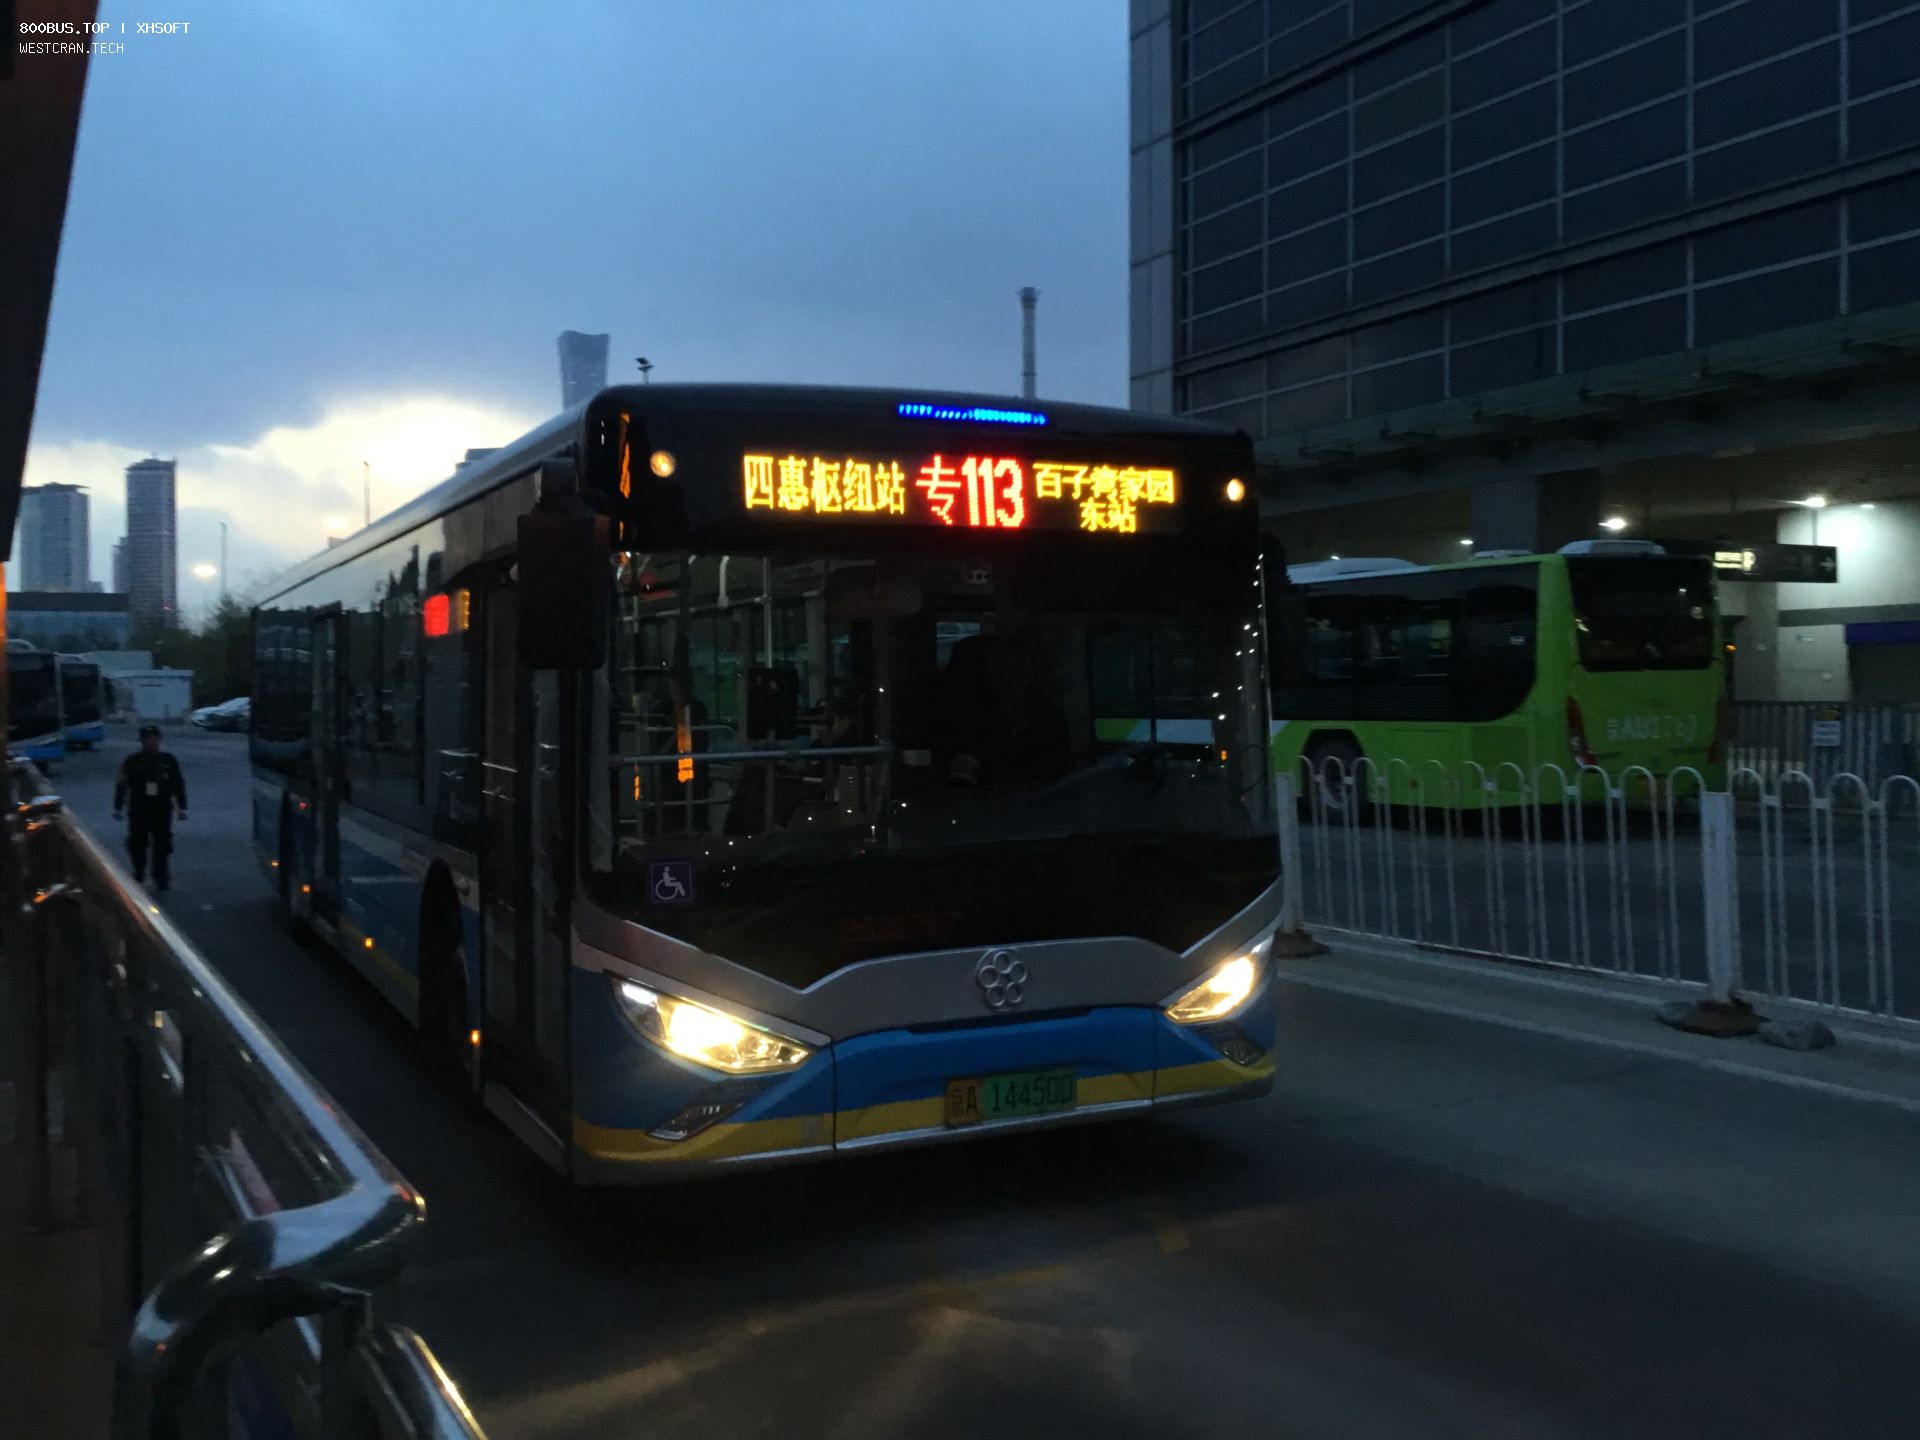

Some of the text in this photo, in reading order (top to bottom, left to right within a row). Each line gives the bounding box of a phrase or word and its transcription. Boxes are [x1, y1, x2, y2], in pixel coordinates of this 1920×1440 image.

[743, 454, 906, 515] 四惠枢纽站
[1079, 497, 1137, 533] 东站
